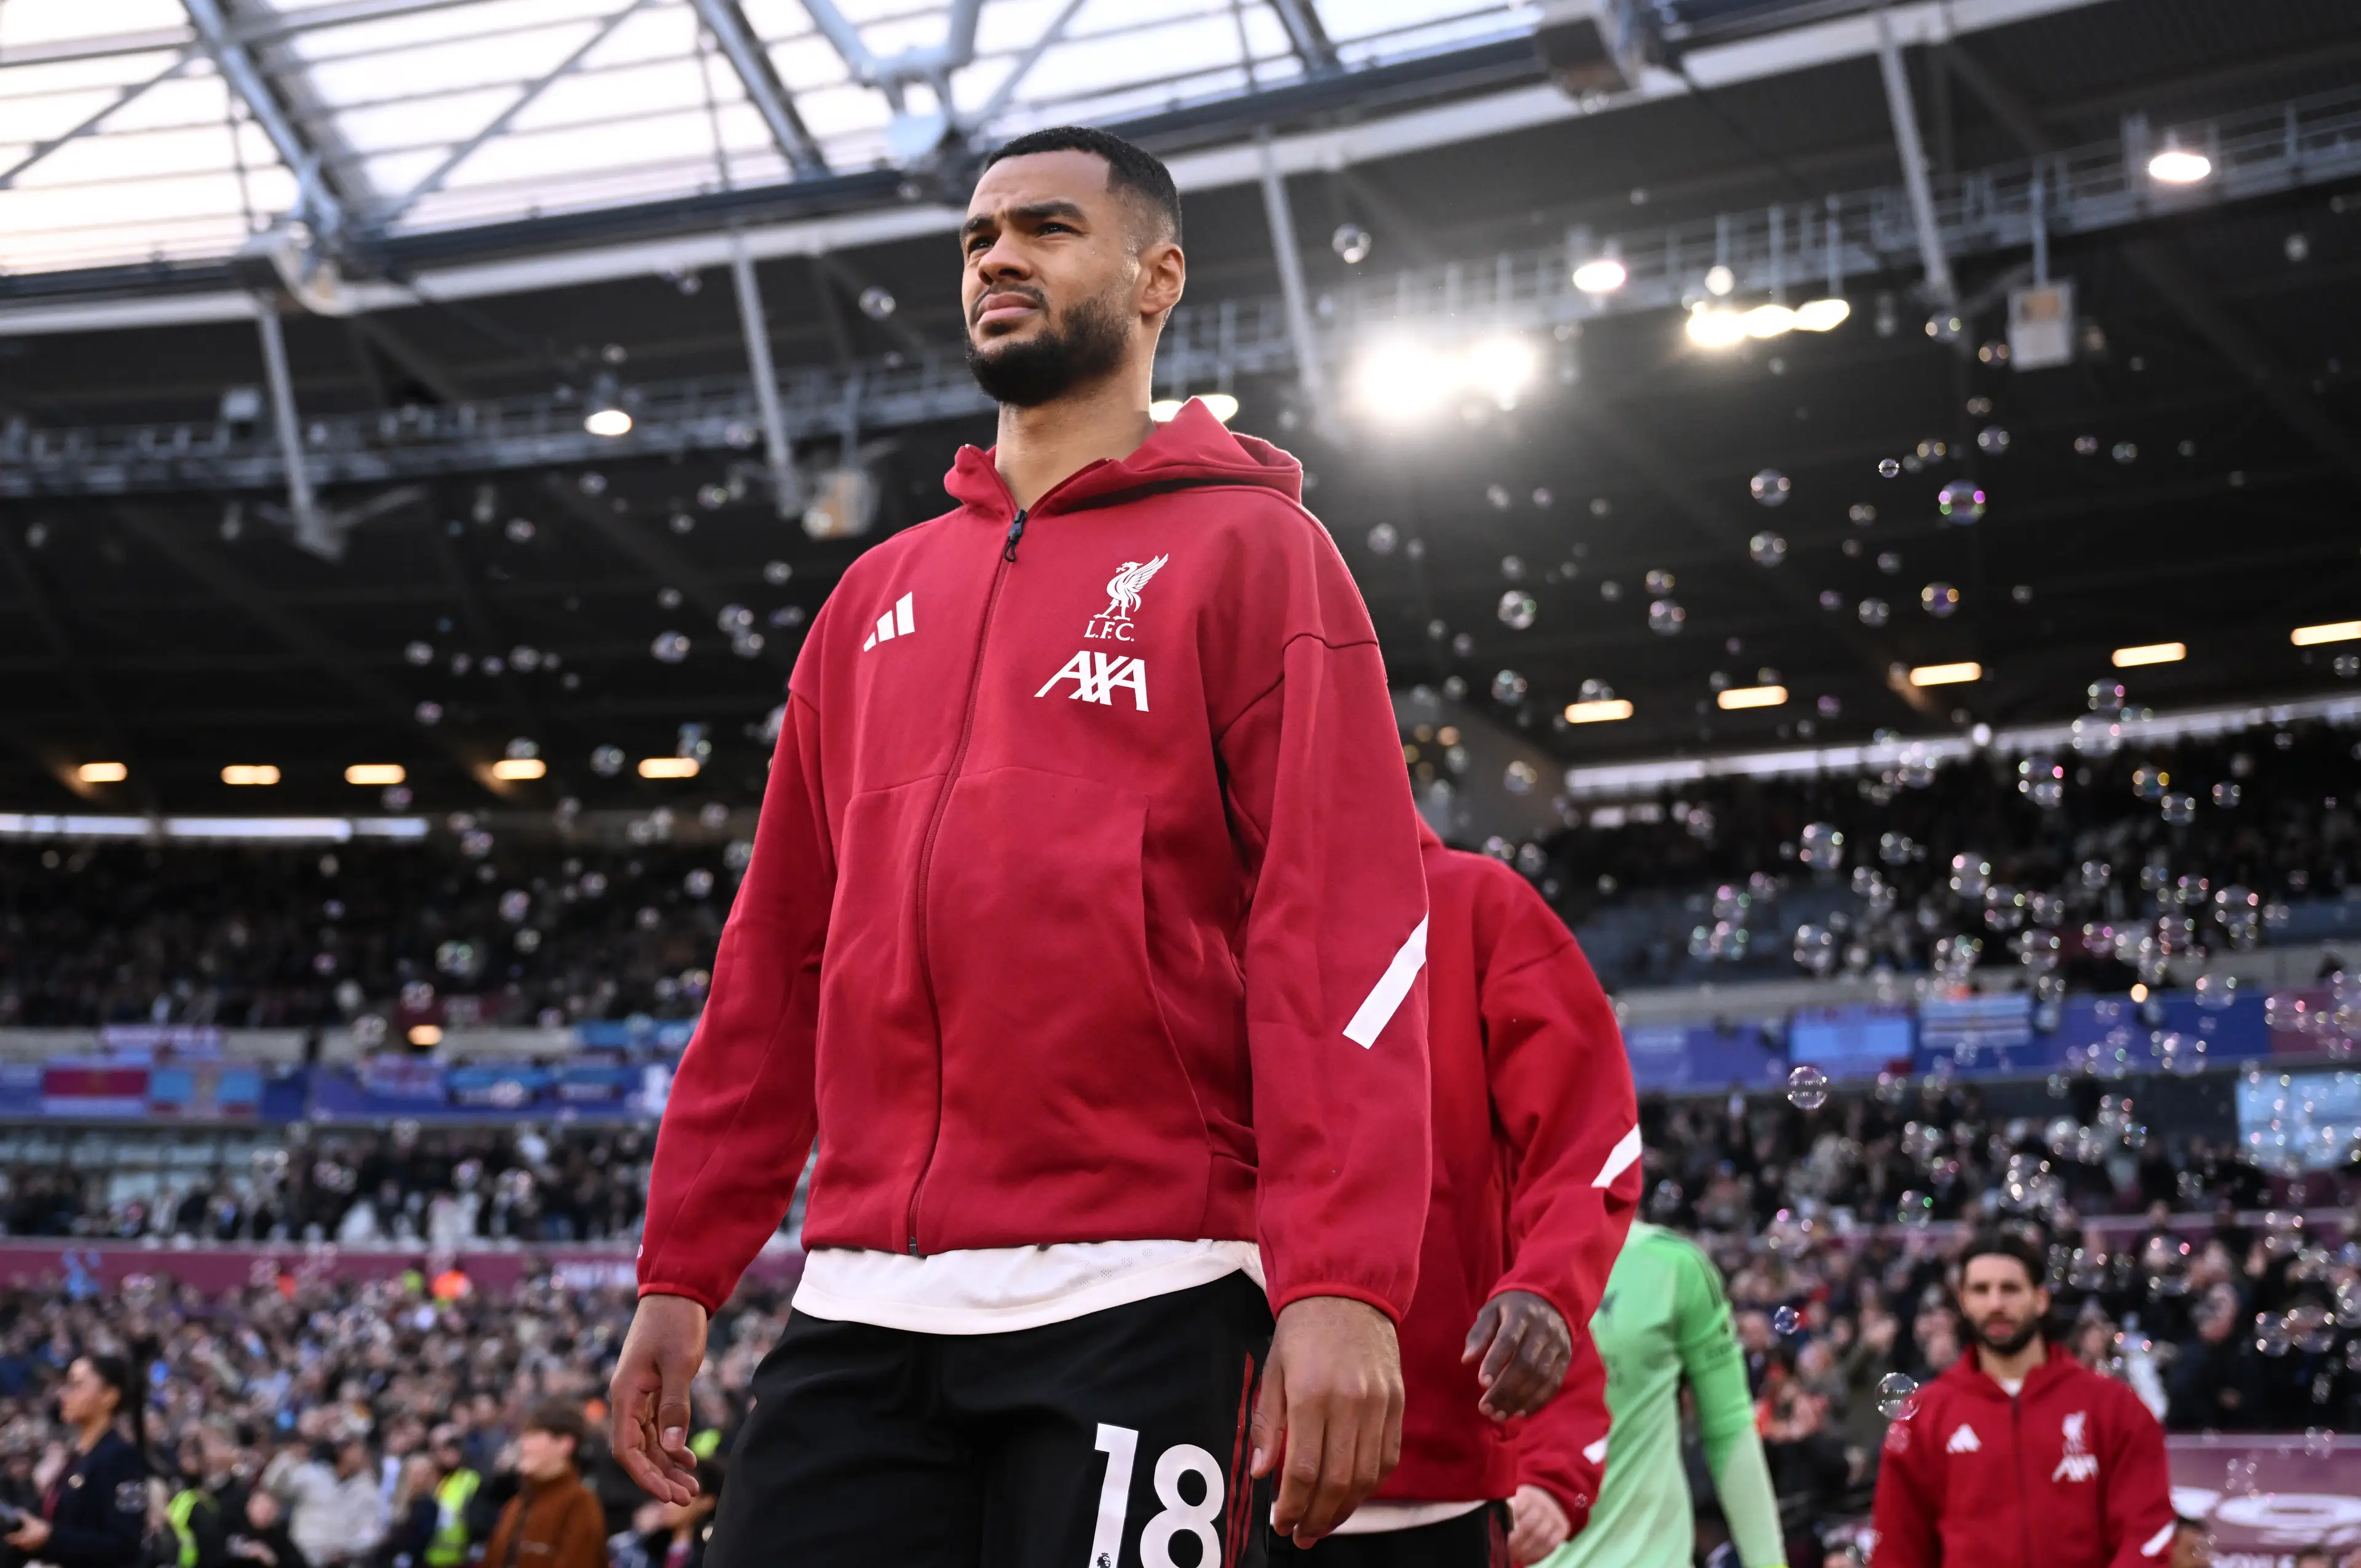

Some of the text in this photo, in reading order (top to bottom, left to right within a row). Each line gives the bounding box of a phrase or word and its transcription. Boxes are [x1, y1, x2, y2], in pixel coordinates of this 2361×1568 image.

[1083, 620, 1135, 642] L.F.C.
[1034, 650, 1149, 712] AXA
[1088, 1422, 1225, 1568] 18
